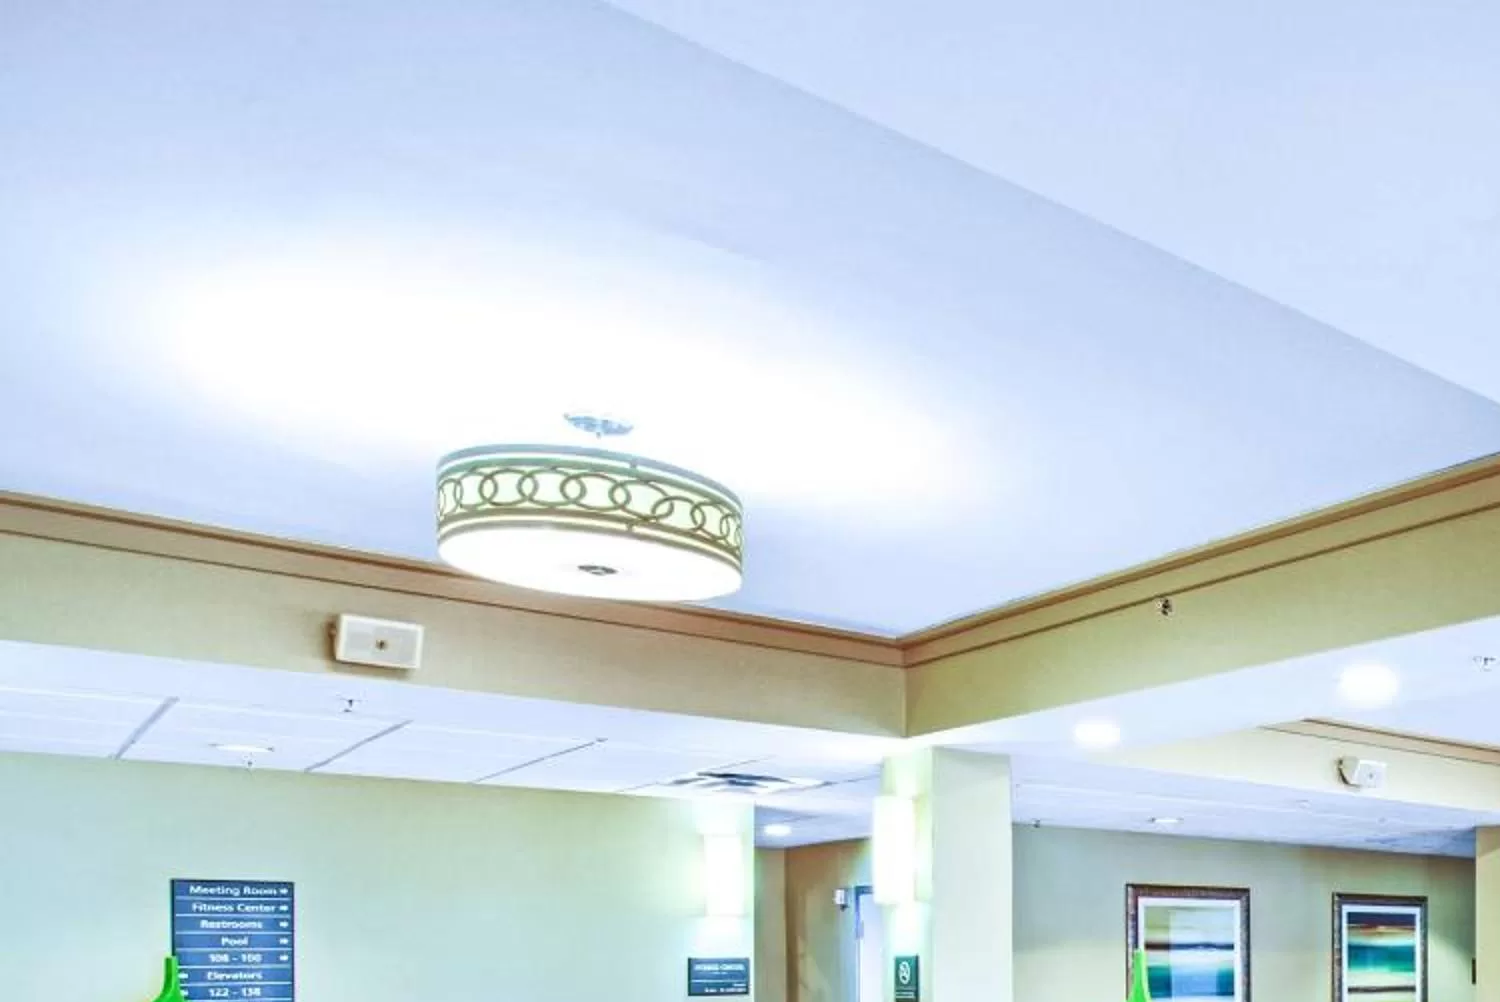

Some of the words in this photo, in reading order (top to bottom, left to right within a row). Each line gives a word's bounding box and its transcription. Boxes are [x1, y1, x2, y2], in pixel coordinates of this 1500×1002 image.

[189, 885, 240, 896] Meeting
[243, 886, 277, 895] Room
[192, 902, 234, 912] Fitness
[237, 903, 276, 912] Center
[200, 919, 263, 929] Restrooms
[221, 936, 248, 946] Pool
[207, 971, 263, 981] Elevators
